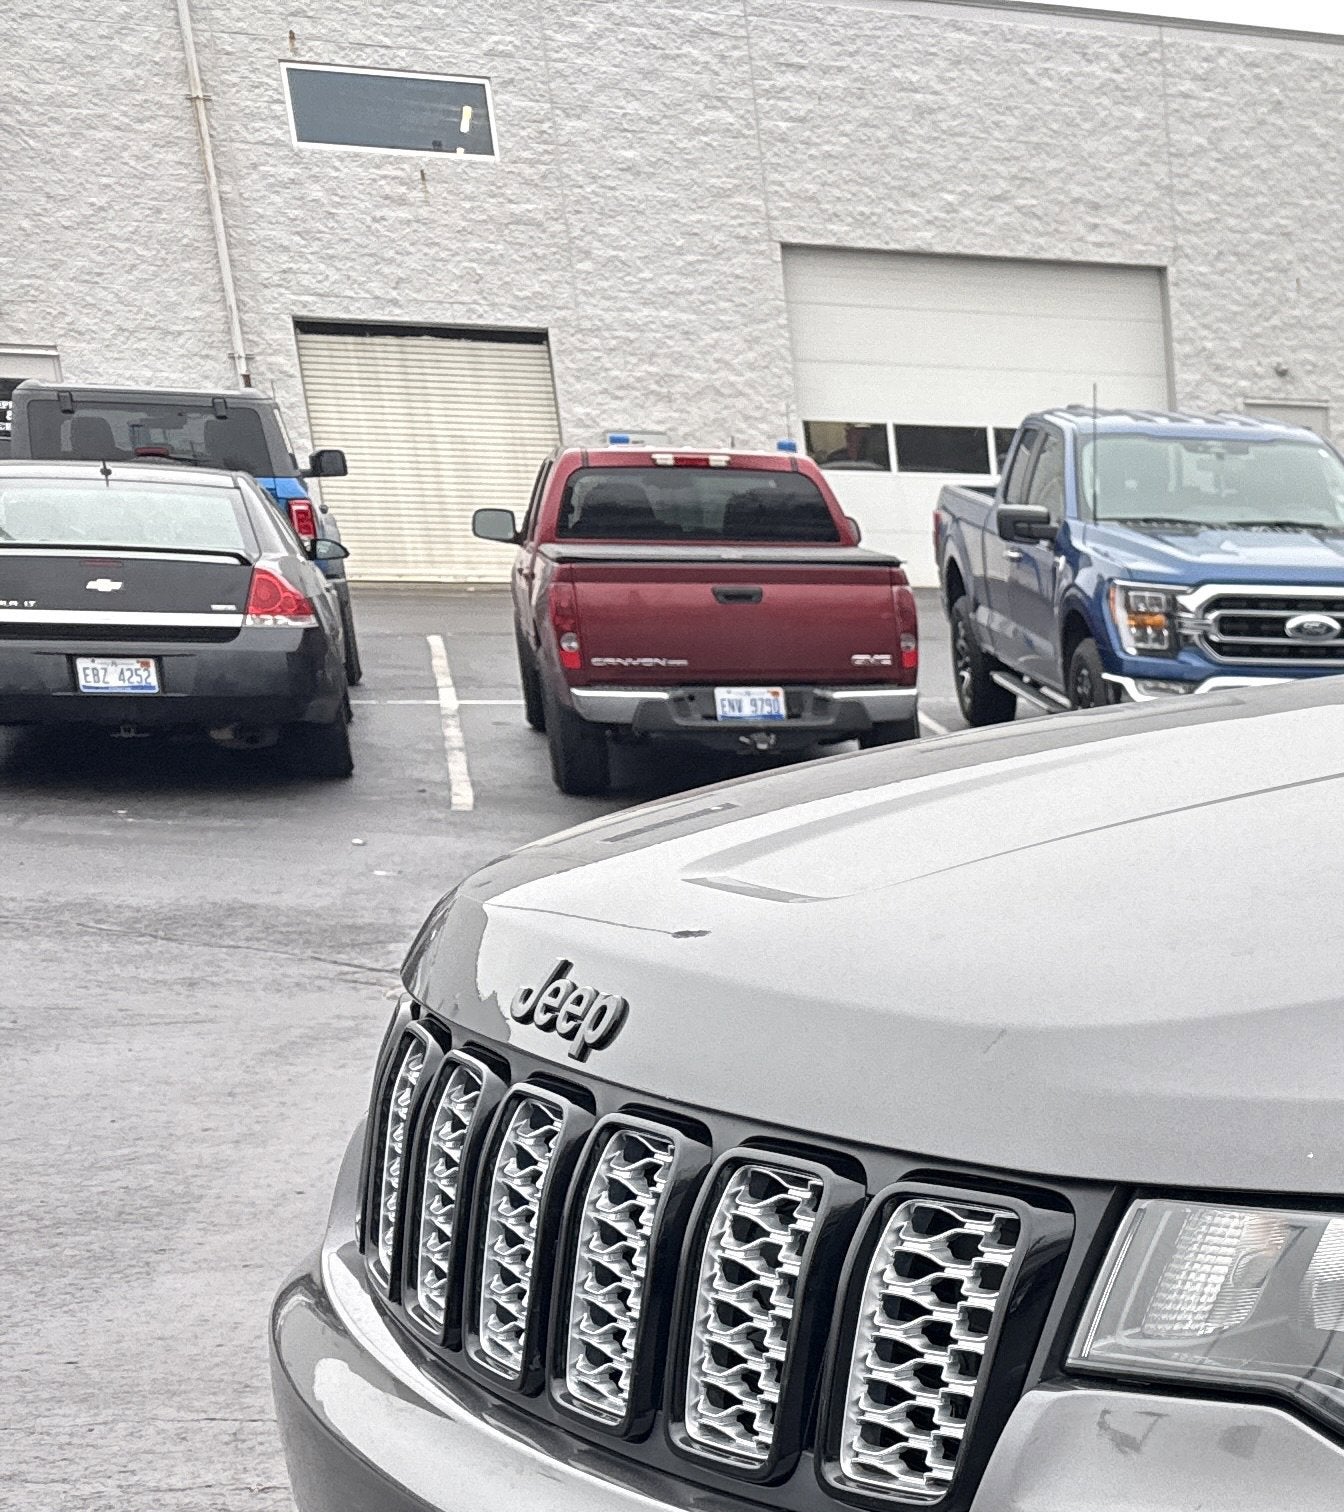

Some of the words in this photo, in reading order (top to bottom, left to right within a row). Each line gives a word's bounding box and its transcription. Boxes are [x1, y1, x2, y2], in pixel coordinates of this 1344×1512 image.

[590, 656, 667, 667] CANYON
[851, 653, 893, 666] GMC
[82, 666, 110, 685] EBZ
[118, 667, 152, 685] 4252
[720, 697, 744, 716] ENV
[509, 956, 631, 1064] Jeep
